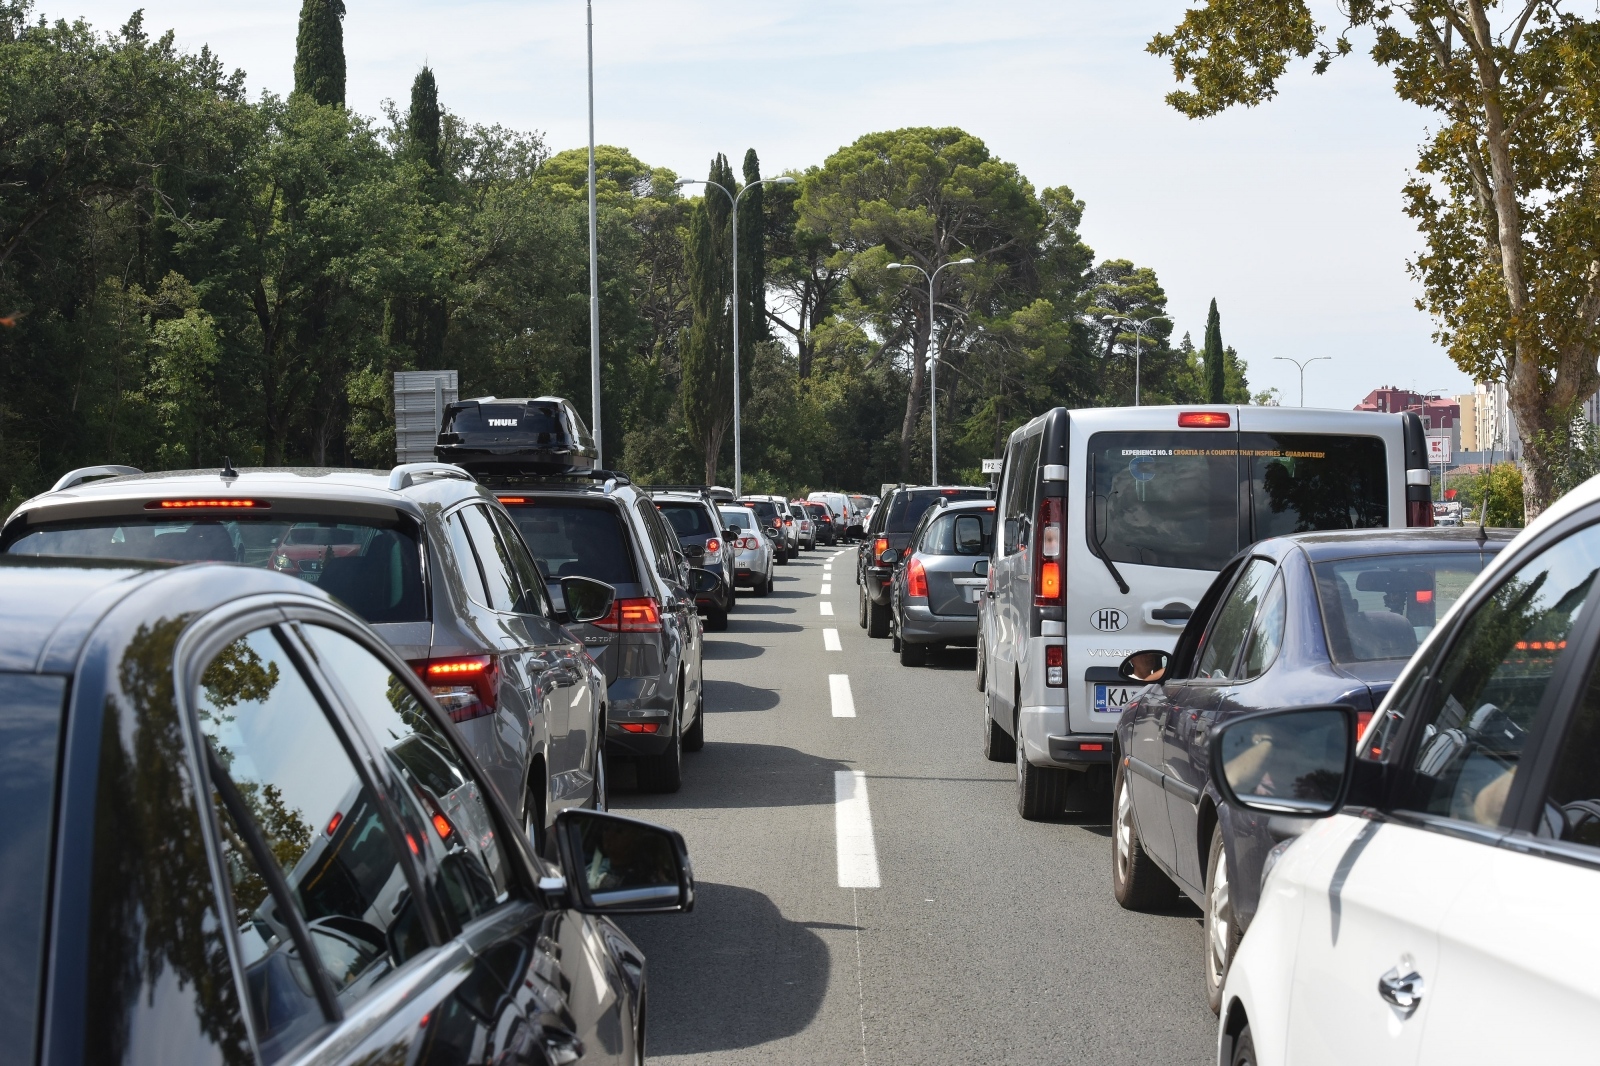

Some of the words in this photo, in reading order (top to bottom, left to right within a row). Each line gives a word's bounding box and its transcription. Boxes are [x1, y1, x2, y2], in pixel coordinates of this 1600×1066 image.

[488, 419, 518, 427] THULE
[1098, 610, 1120, 630] HR
[1087, 649, 1140, 657] VIVAR
[1108, 688, 1129, 706] KA
